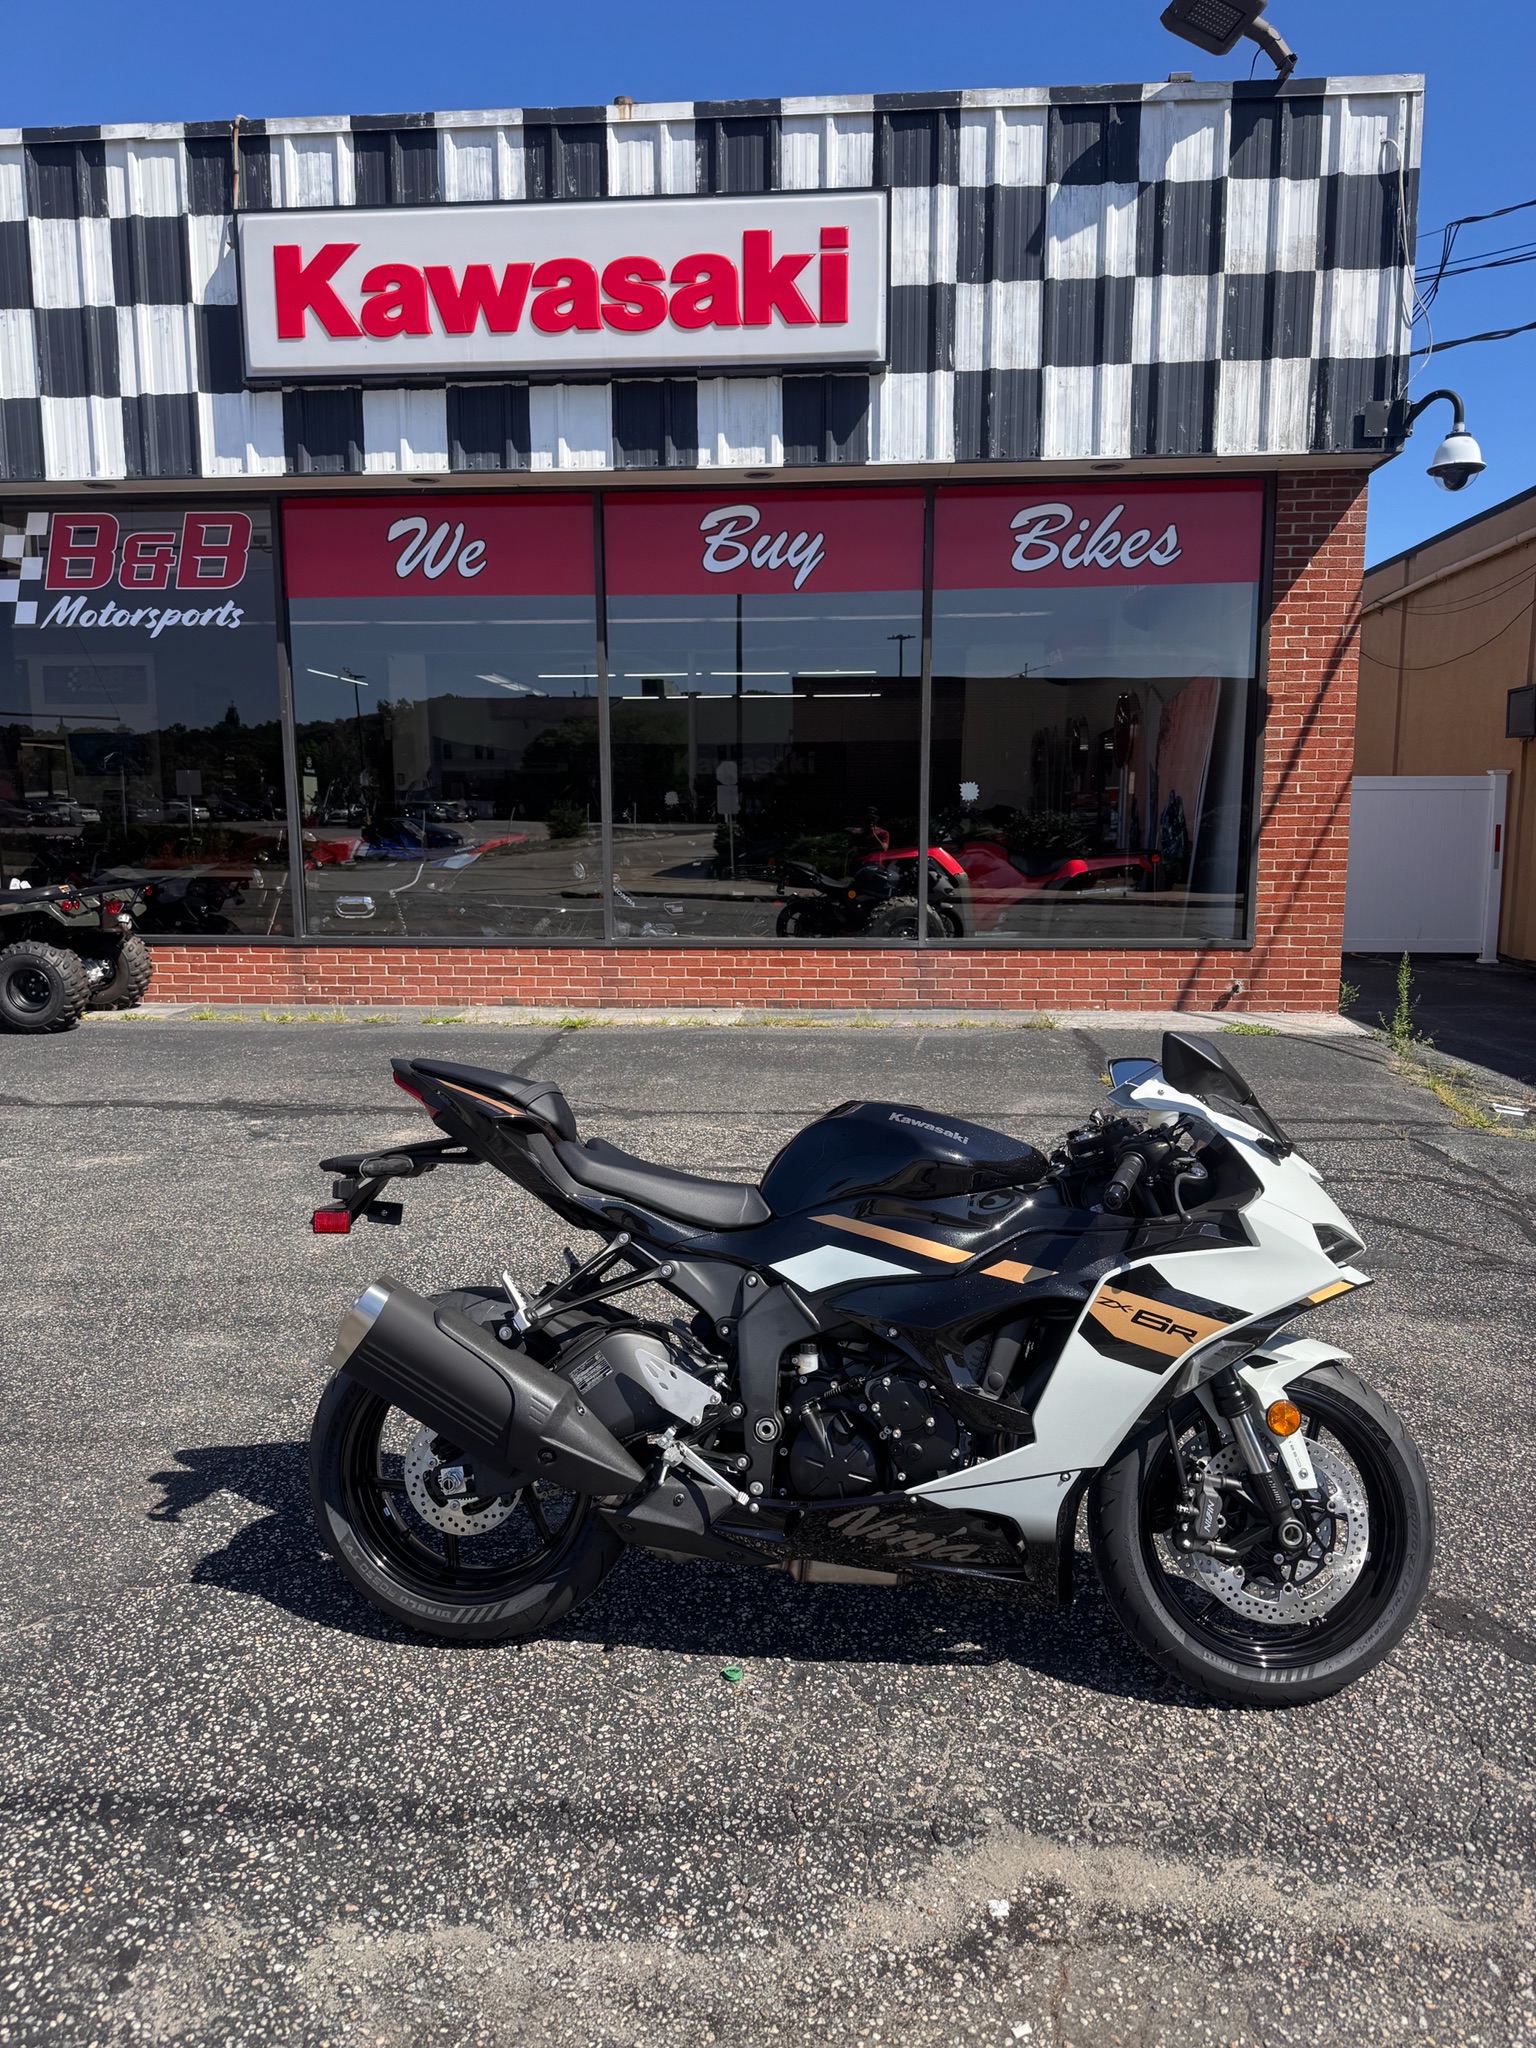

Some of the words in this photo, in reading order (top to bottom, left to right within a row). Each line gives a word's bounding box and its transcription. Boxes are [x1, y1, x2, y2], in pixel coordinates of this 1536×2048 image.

[273, 225, 850, 339] Kawasaki
[44, 511, 253, 591] B&B
[387, 515, 488, 580] We
[698, 503, 826, 591] Buy
[1009, 502, 1182, 573] Bikes
[41, 595, 245, 639] Motorsports
[888, 1111, 970, 1145] Kawasaki
[827, 1505, 985, 1562] Ninja
[358, 1560, 397, 1599] ROSSO
[397, 1593, 452, 1619] DIABLO
